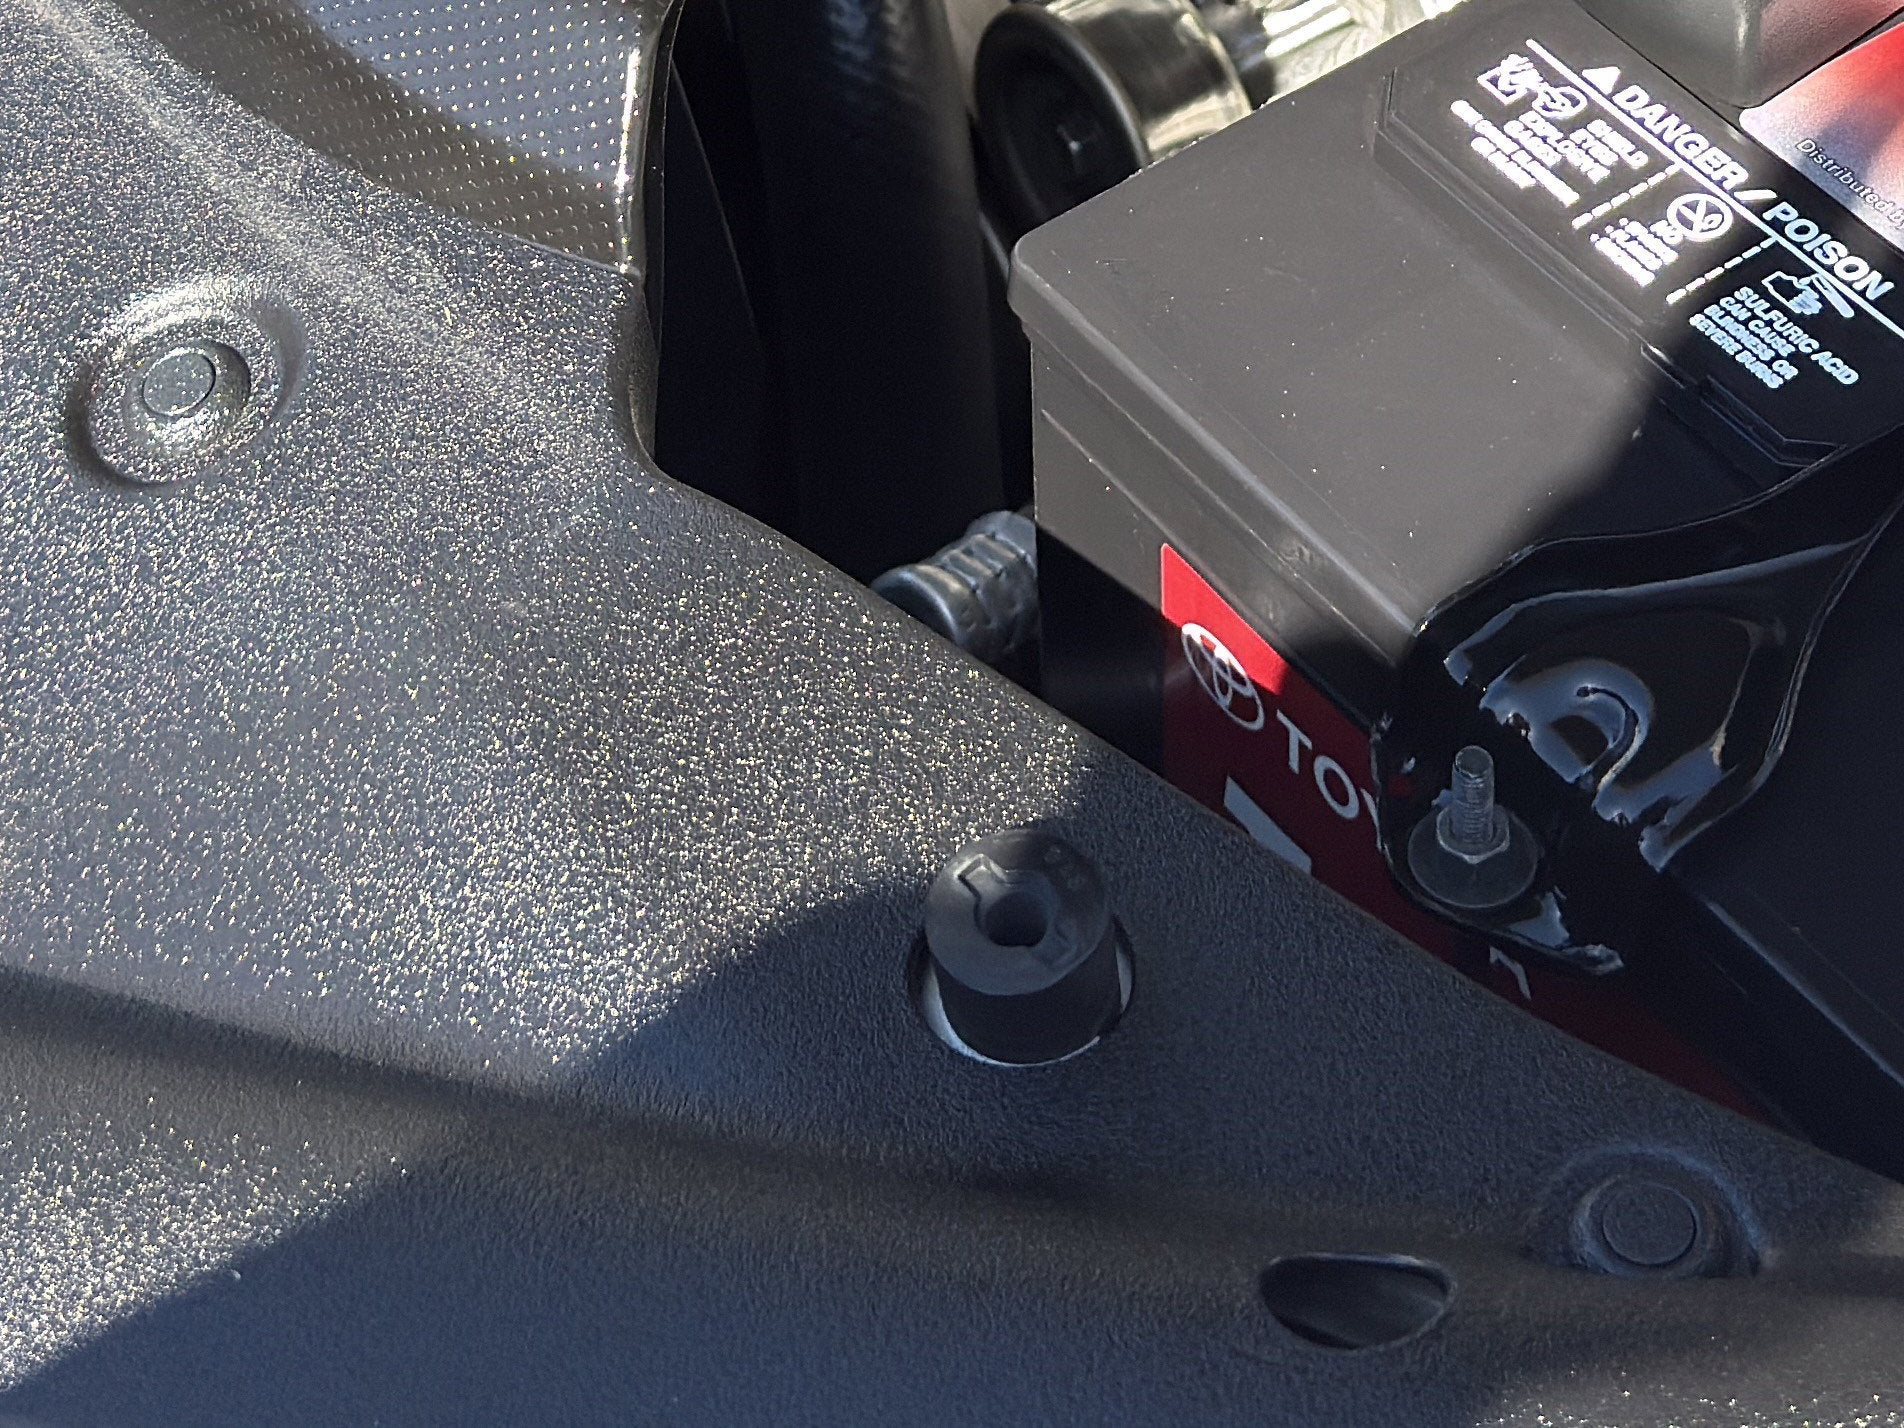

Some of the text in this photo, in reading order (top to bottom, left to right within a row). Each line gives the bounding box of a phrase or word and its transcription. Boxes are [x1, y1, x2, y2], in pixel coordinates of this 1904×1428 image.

[1612, 85, 1750, 190] DANGER
[1763, 201, 1895, 301] POISON
[1797, 140, 1891, 216] Distributed
[1689, 314, 1784, 388] SEVERE BURNS
[1705, 305, 1799, 380] BLINDNESS OR
[1720, 297, 1797, 355] CAN CAUSE
[1735, 286, 1859, 385] SULFURIC ACID
